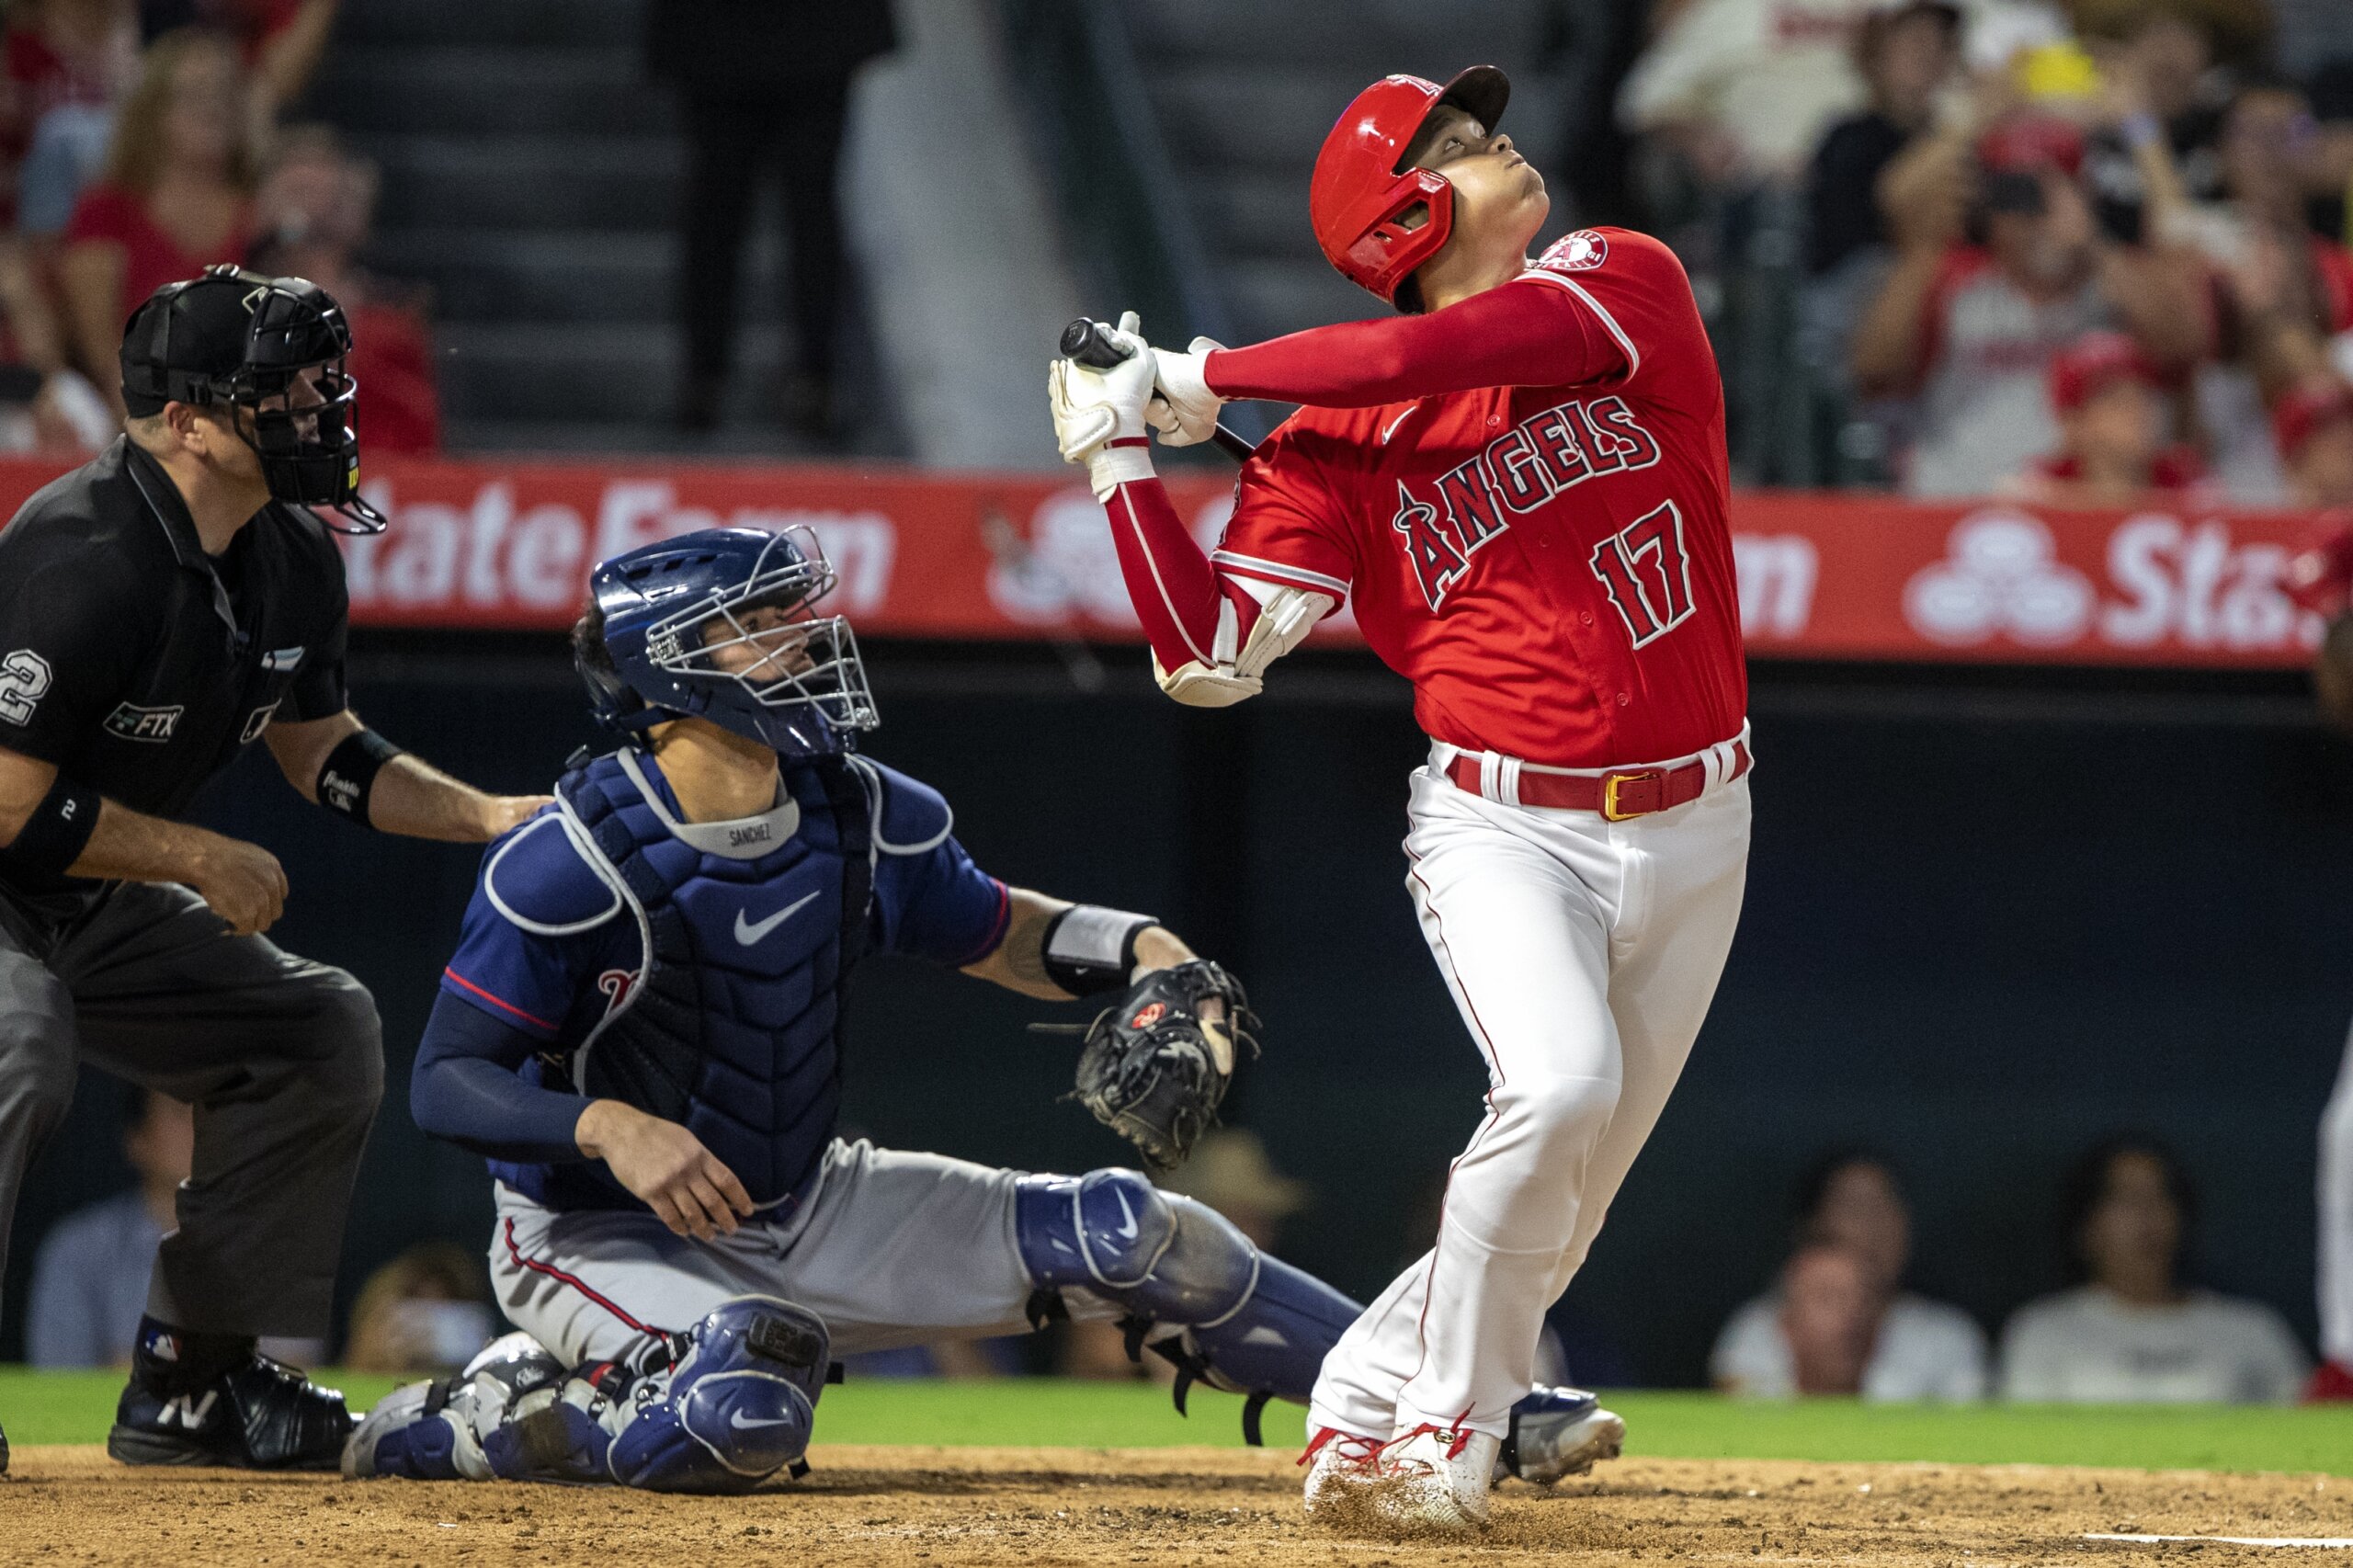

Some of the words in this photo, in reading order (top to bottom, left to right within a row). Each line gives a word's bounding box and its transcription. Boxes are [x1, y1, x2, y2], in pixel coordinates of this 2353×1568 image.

[343, 472, 585, 612] tate
[1392, 395, 1663, 614] ANGELS
[1588, 499, 1698, 650] 17
[0, 648, 53, 727] 2
[134, 711, 178, 738] FTX
[61, 798, 77, 822] 2
[729, 823, 771, 847] SANCHEZ
